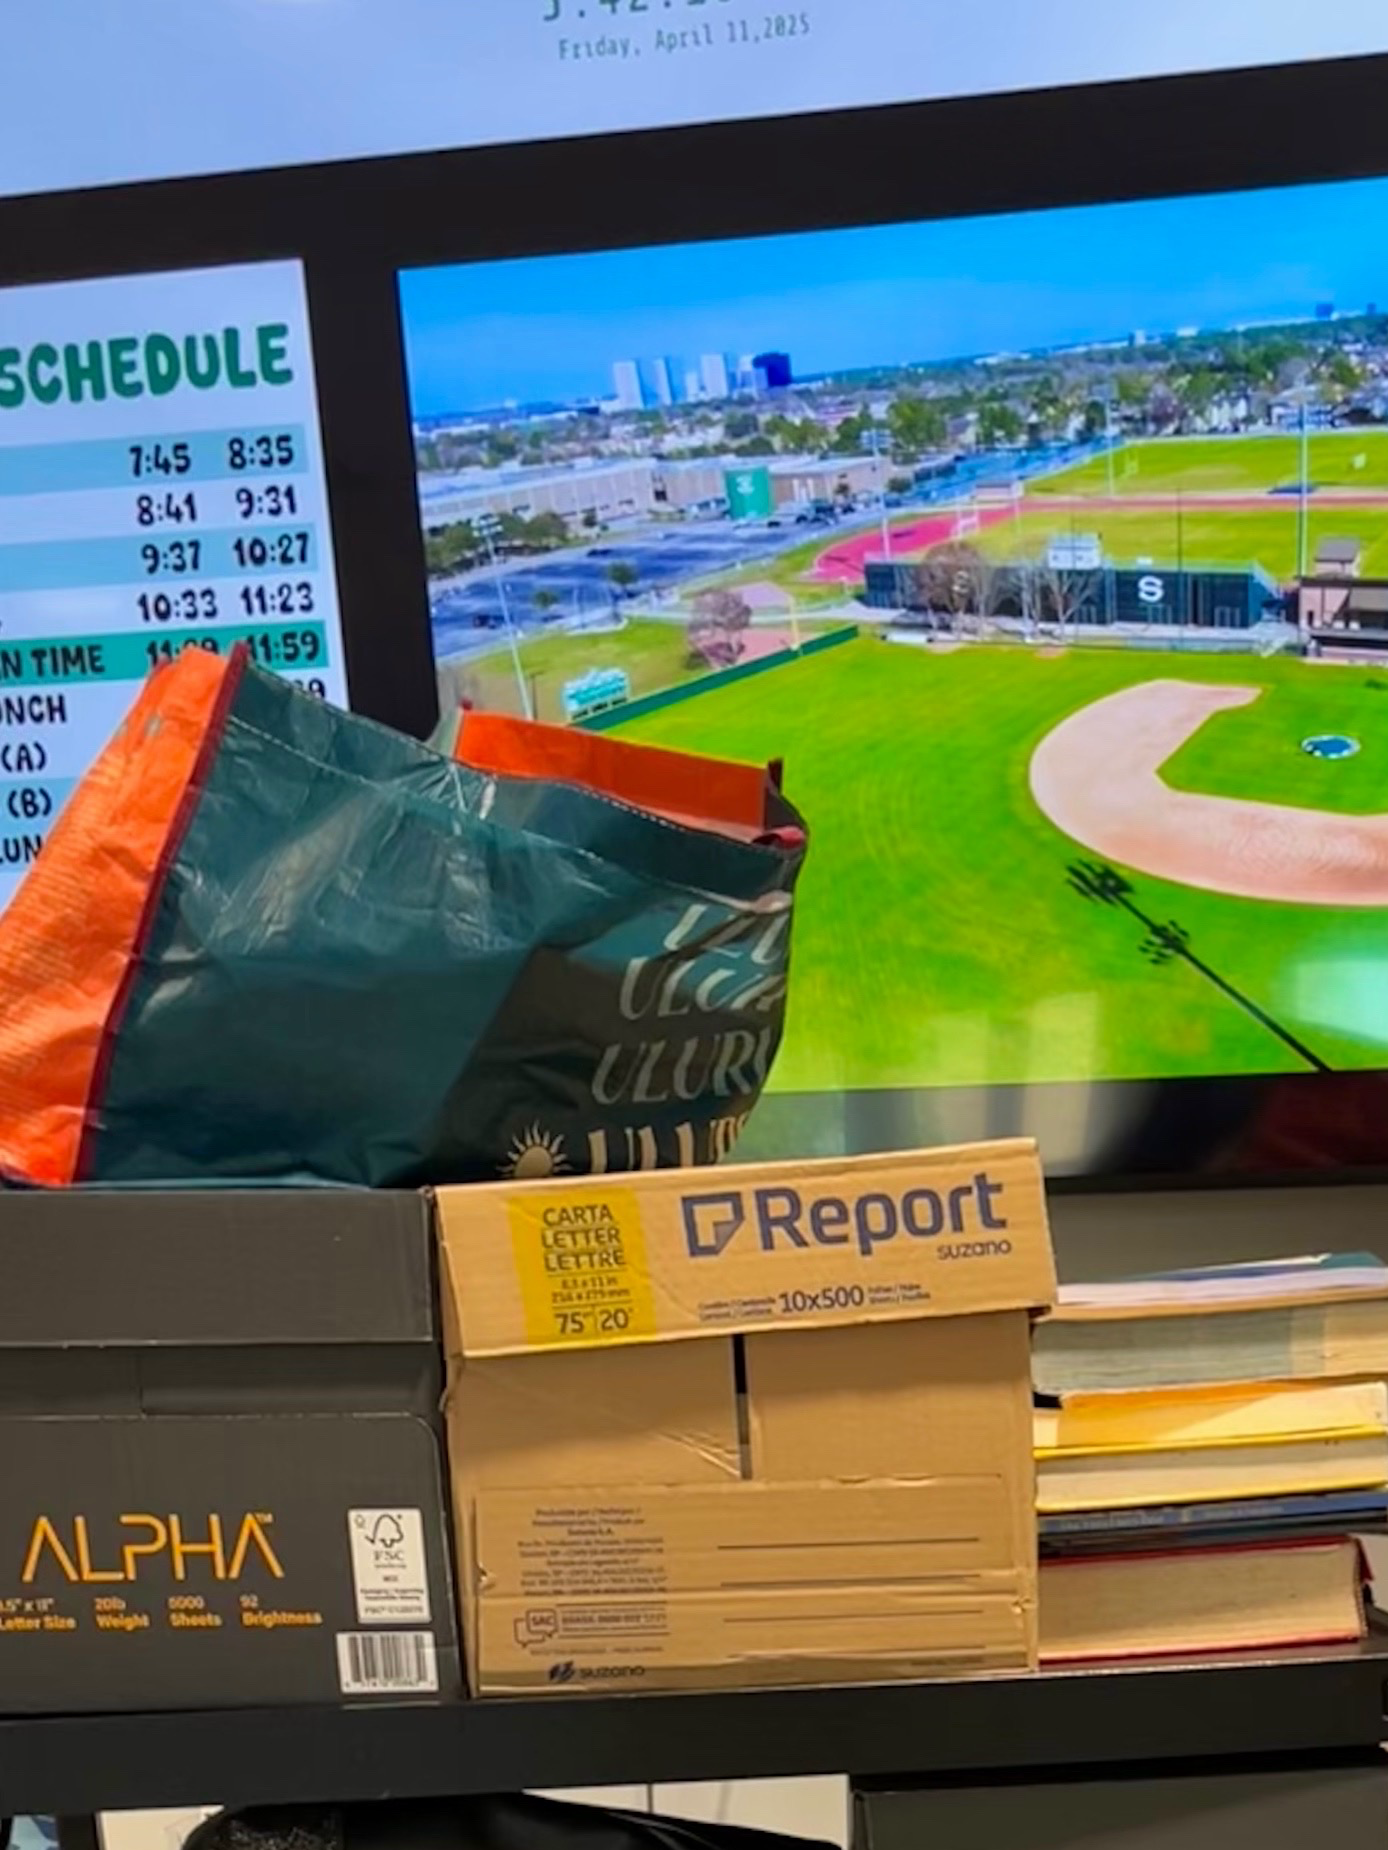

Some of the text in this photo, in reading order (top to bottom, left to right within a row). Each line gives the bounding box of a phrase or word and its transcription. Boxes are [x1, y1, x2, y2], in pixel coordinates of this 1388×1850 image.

[558, 37, 641, 60] Friday,
[655, 23, 713, 53] April
[0, 323, 294, 408] SCHEDULE
[129, 434, 294, 477] 7:45 8:35
[137, 484, 297, 527] 8:41 9:31
[141, 532, 309, 574] 9:37 10:27
[138, 582, 314, 623] 10:33 11:23
[32, 645, 105, 677] TIME
[2, 742, 45, 772] (A)
[8, 788, 52, 818] (B)
[542, 1203, 613, 1227] CARTA
[755, 1172, 1007, 1257] Report
[541, 1227, 621, 1249] LETTER
[937, 1238, 1012, 1262] suzano
[544, 1250, 625, 1272] LETTRE
[778, 1285, 865, 1314] 10x500
[21, 1513, 285, 1582] ALPHA
[0, 1611, 39, 1631] Letter
[97, 1613, 149, 1631] Weight
[170, 1611, 223, 1628] Sheets
[242, 1610, 323, 1629] Brightness
